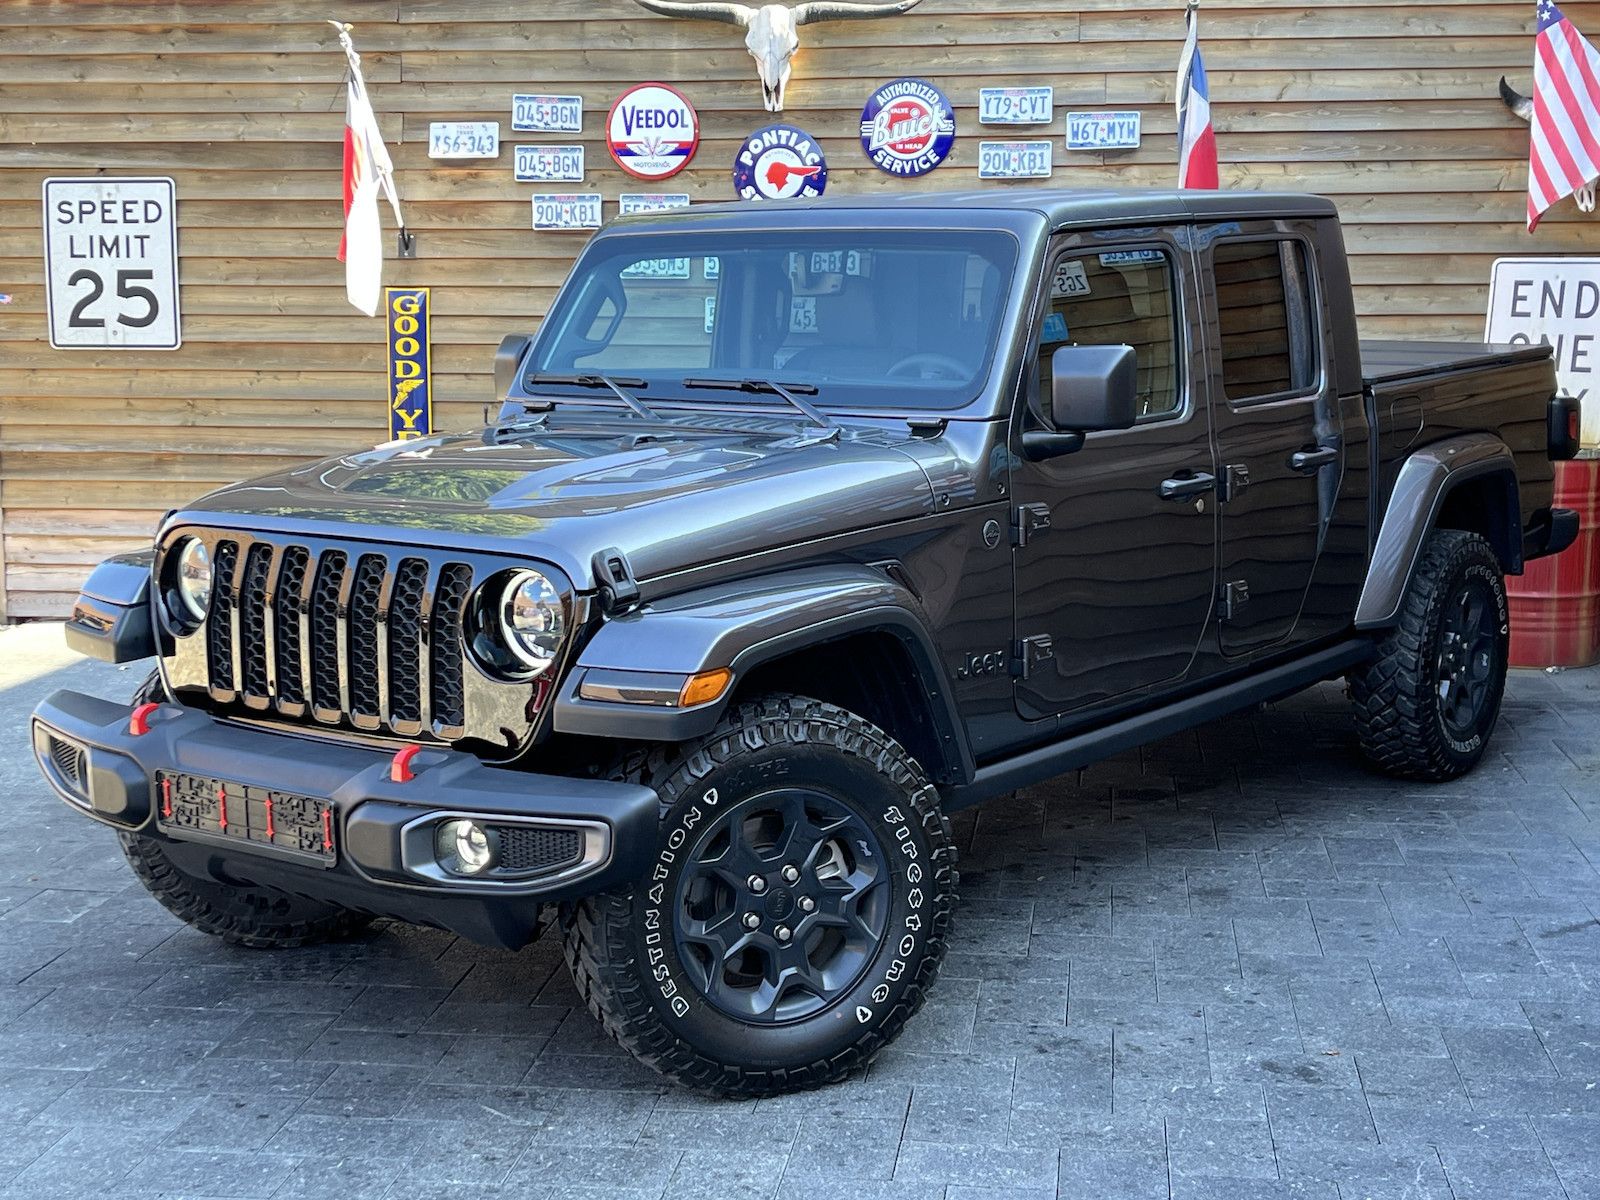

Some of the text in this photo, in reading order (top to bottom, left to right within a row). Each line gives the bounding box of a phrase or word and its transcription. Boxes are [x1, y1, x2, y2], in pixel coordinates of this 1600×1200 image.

[876, 82, 939, 106] AUTHORIZED
[622, 105, 688, 136] VEEDOL
[869, 102, 947, 151] Buick
[740, 129, 820, 168] PONTIAC
[873, 149, 940, 174] SERVICE
[57, 200, 162, 225] SPEED
[69, 234, 150, 259] LIMIT
[68, 268, 159, 328] 25
[1510, 280, 1600, 318] END
[957, 650, 1004, 681] Jeep
[646, 808, 702, 1018] DESTINATION
